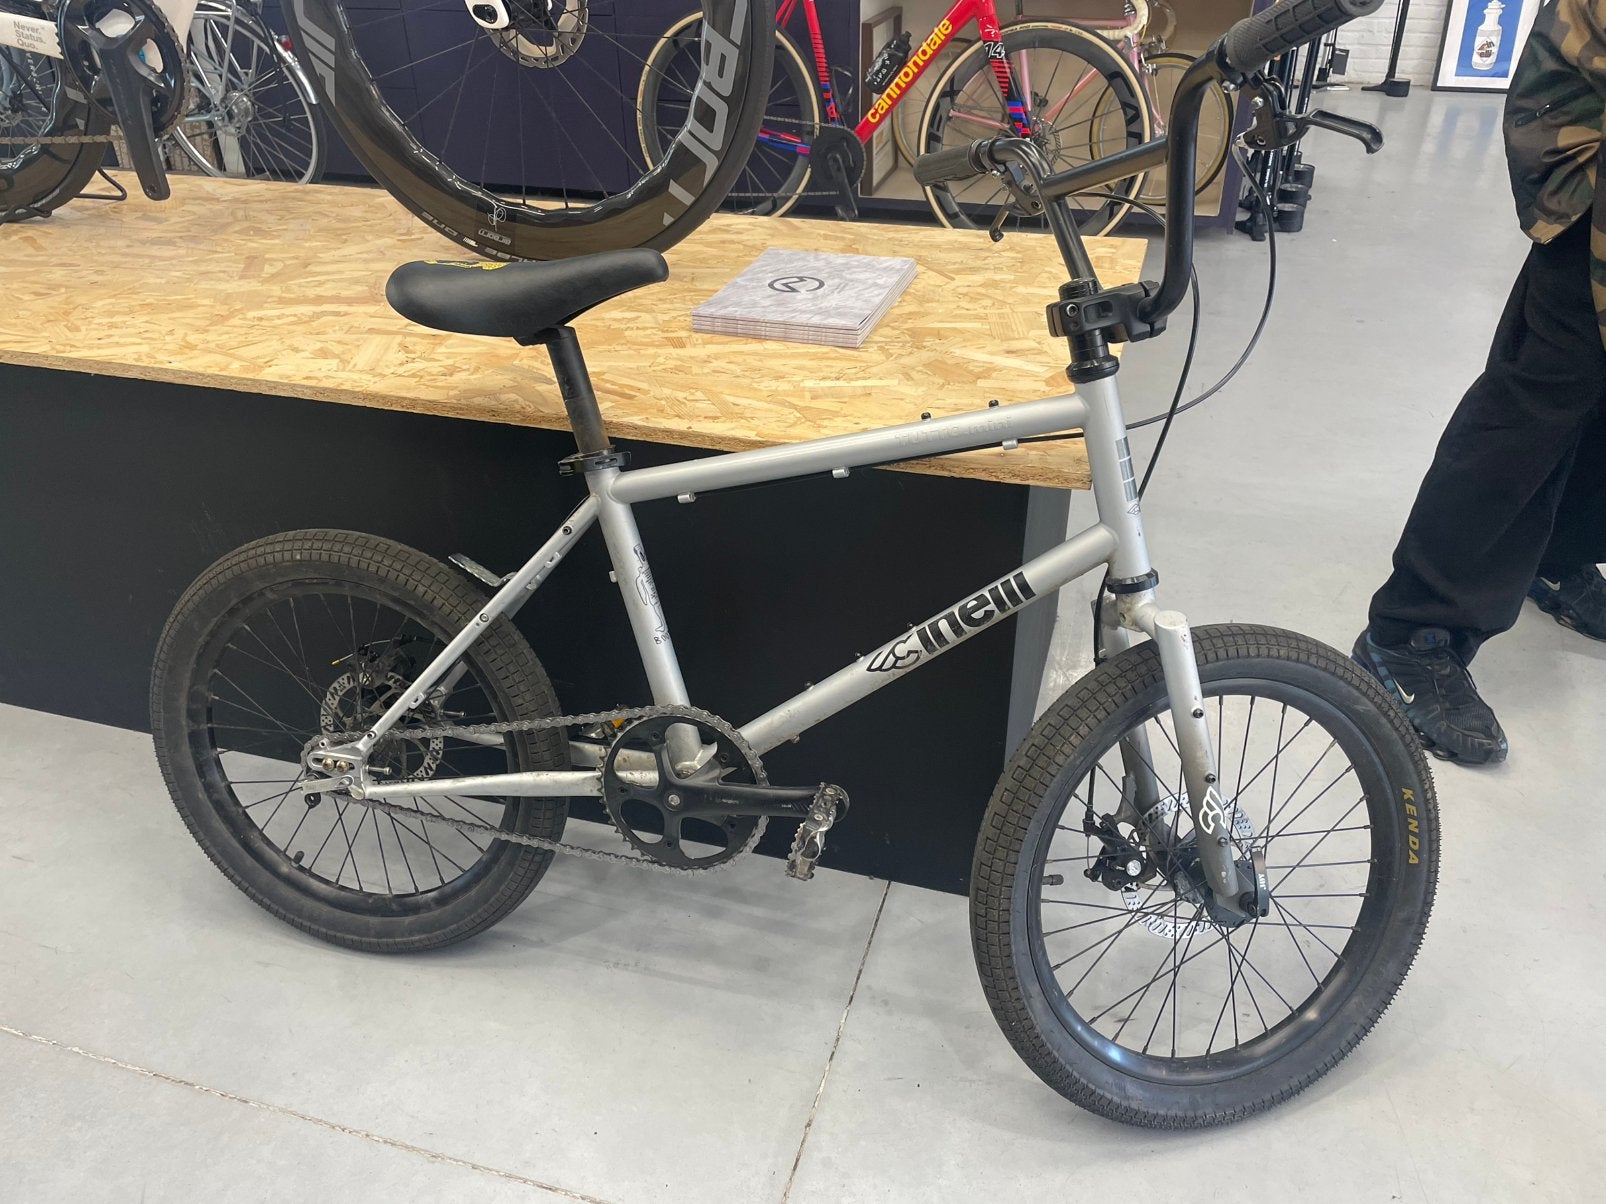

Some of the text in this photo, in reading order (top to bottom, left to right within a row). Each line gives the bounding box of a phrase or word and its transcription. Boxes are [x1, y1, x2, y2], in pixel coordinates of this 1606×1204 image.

[15, 30, 46, 44] Status.
[17, 39, 39, 50] Quo.
[867, 19, 953, 123] cannondale
[866, 571, 1037, 672] Cinelli
[1402, 787, 1420, 864] KENDA
